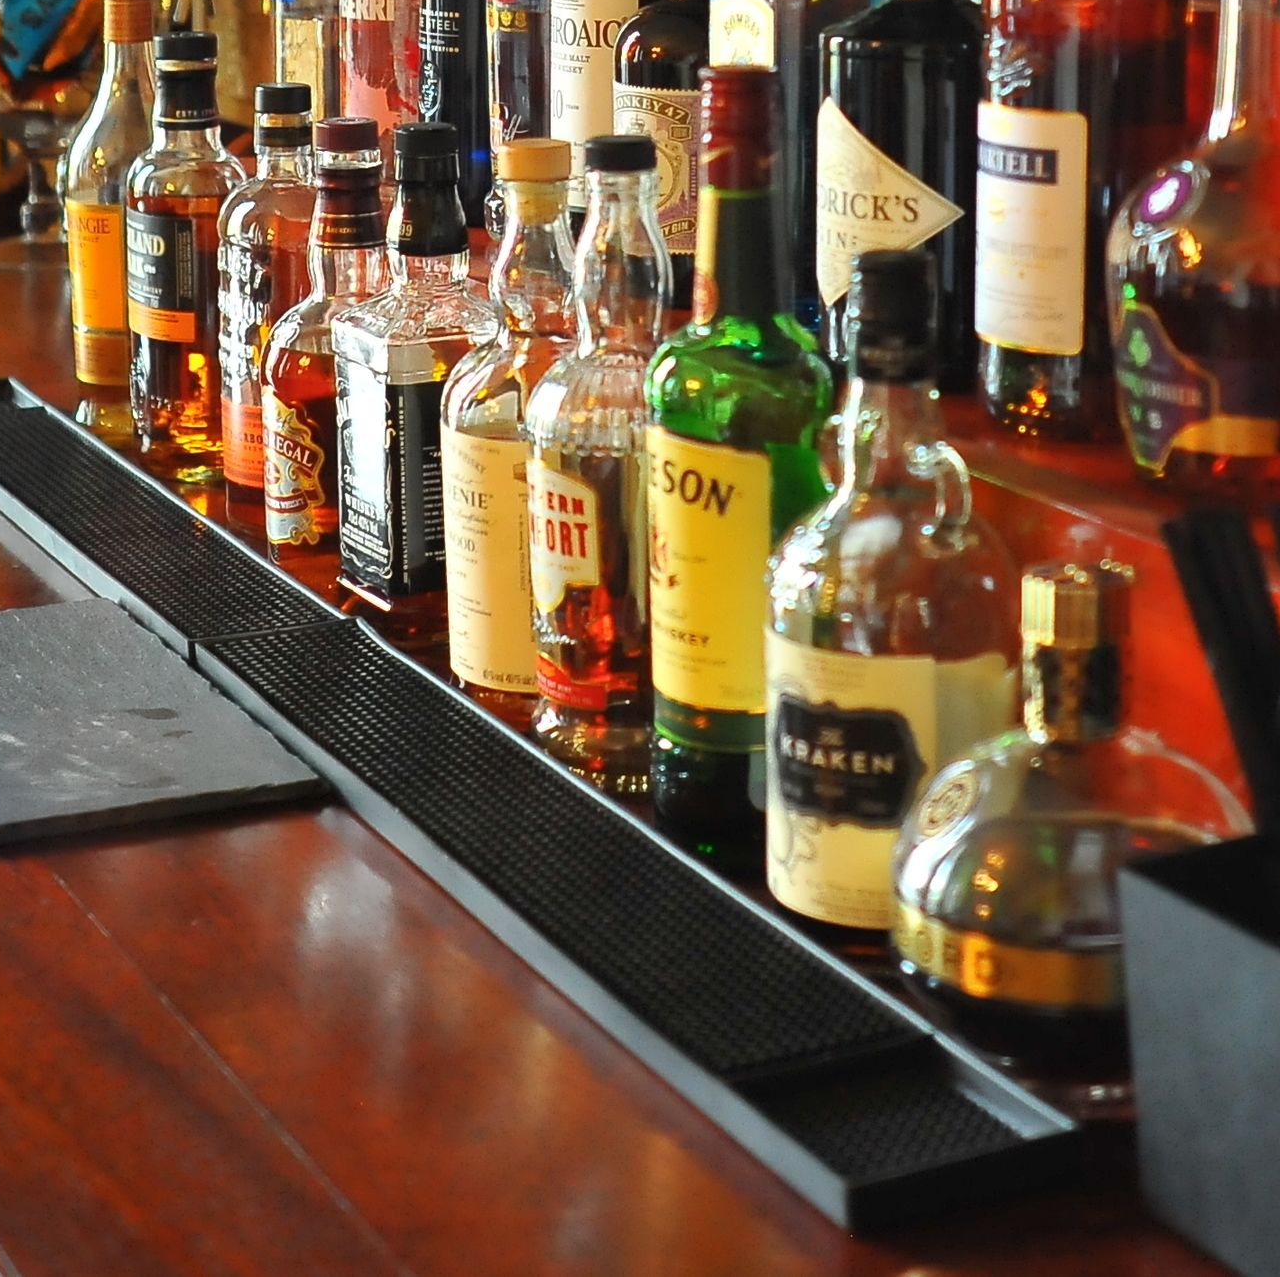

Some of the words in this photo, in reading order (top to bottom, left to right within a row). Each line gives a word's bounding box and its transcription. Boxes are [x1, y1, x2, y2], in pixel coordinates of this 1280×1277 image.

[664, 103, 686, 121] 47
[671, 222, 689, 235] GIN
[400, 457, 408, 526] CRAFTSMANSHIP
[779, 732, 895, 775] KRAKEN
